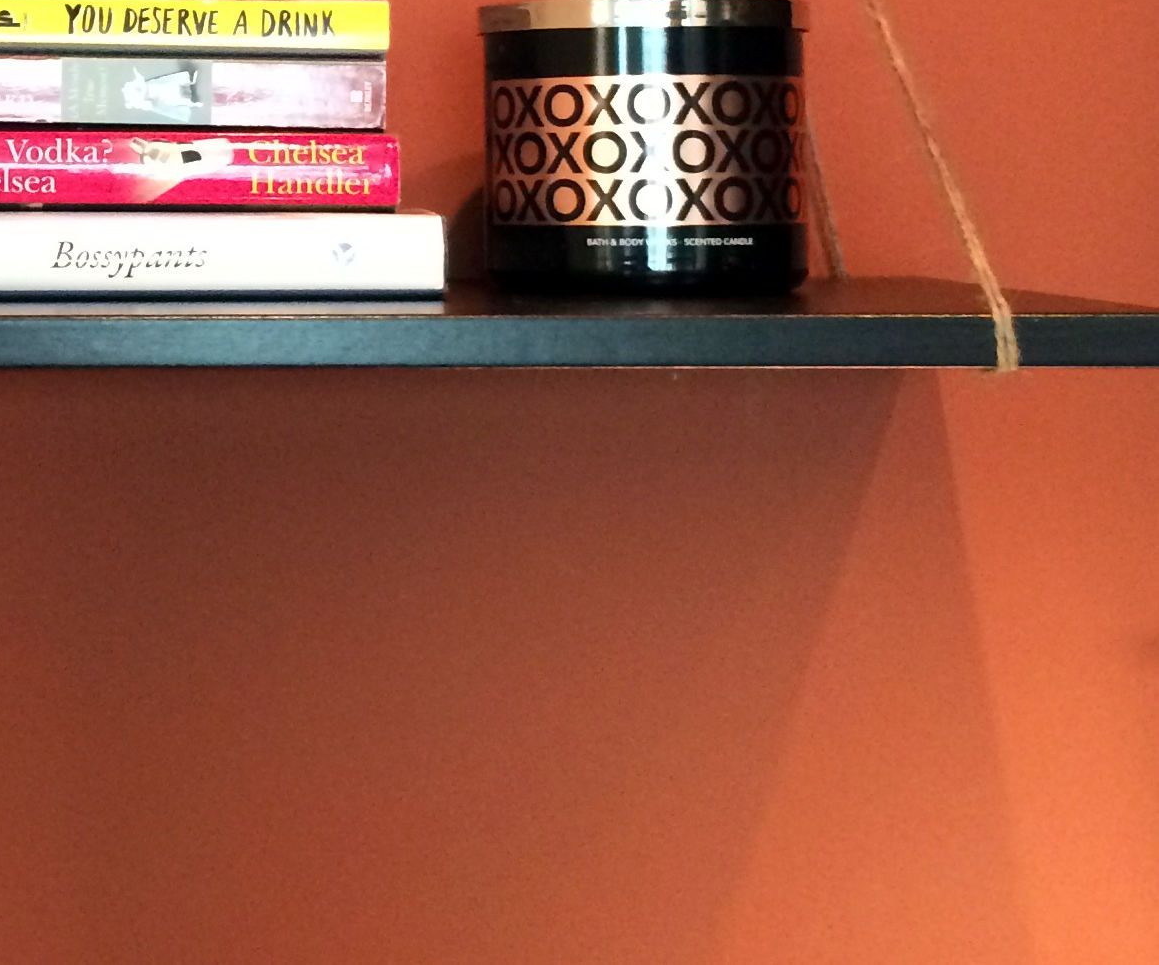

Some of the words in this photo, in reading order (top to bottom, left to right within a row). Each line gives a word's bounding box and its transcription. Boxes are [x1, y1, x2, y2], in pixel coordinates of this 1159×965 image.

[65, 3, 113, 34] YOU
[123, 6, 218, 36] DESERVE
[233, 9, 248, 35] A
[261, 8, 335, 37] DRINK
[5, 138, 114, 165] Vodka?
[248, 139, 366, 166] Chelsea
[249, 174, 374, 197] Handler
[586, 237, 609, 247] BATH
[619, 237, 643, 247] BODY
[683, 237, 721, 246] SCENTED
[723, 237, 753, 246] CANDLE
[50, 241, 208, 279] Bossypants
